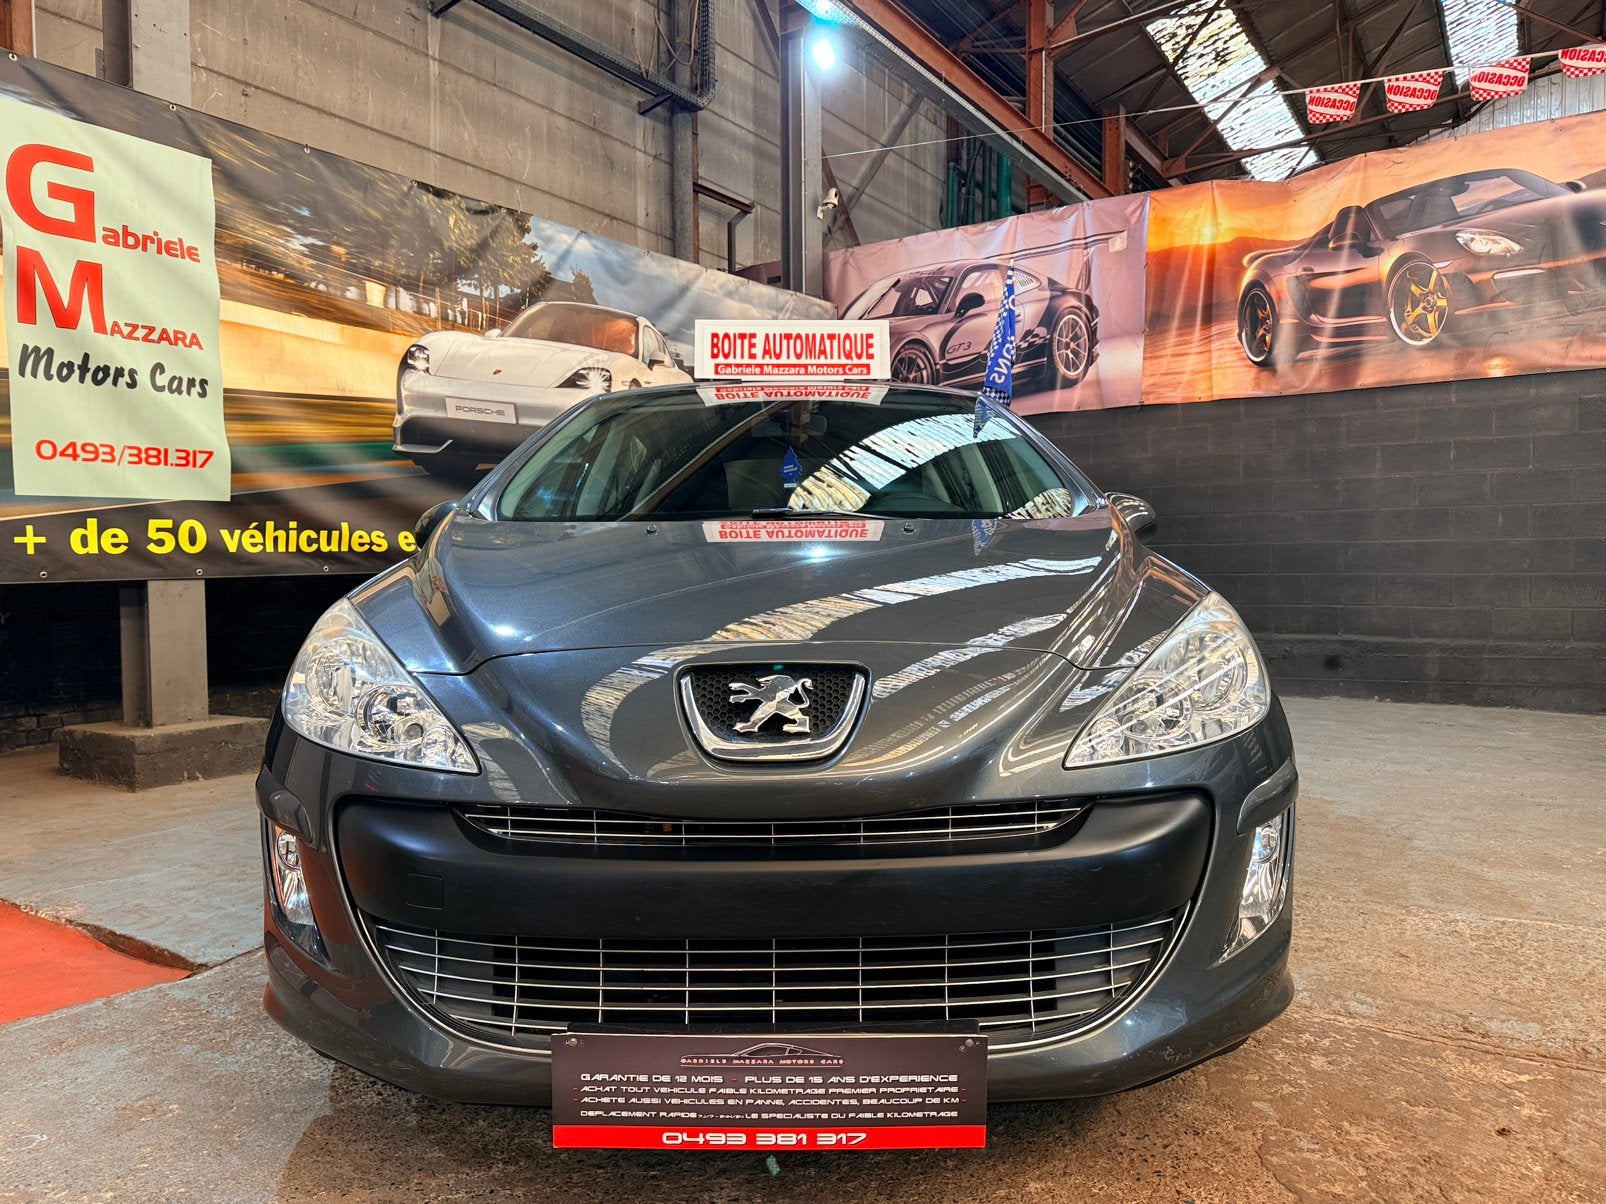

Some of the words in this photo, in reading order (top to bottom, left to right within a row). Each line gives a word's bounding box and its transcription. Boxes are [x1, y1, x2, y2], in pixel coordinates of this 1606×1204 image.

[16, 245, 204, 350] MAZZARA
[710, 332, 757, 360] BOITE
[762, 332, 875, 361] AUTOMATIQUE
[18, 343, 138, 390] Motors
[150, 362, 209, 399] Cars
[717, 364, 761, 375] Gabriele
[763, 365, 805, 375] Mazzara
[807, 365, 844, 375] Motors
[845, 364, 868, 375] Cars
[455, 405, 505, 416] PORSCHE
[35, 439, 215, 469] 0493/381.317
[69, 517, 129, 555] de
[147, 519, 208, 555] 50
[220, 520, 389, 554] véhicules
[580, 1073, 649, 1082] GARANTIE
[652, 1074, 671, 1083] DE
[674, 1075, 688, 1083] 12
[691, 1075, 724, 1083] MOIS
[745, 1075, 782, 1084] PLUS
[785, 1076, 805, 1084] DE
[808, 1076, 824, 1084] 15
[827, 1075, 856, 1084] ANS
[859, 1074, 958, 1084] D'EXPERIENCE
[580, 1085, 618, 1093] ACHAT
[653, 1086, 707, 1094] VEHICULE
[708, 1087, 748, 1095] FAIBLE
[828, 1087, 877, 1095] PREMIER
[879, 1086, 959, 1094] PROPRIETAIRE
[580, 1096, 626, 1104] ACHETE
[580, 1110, 658, 1118] DEPLACEMENT
[661, 1132, 747, 1145] 0493
[755, 1133, 808, 1145] 381
[816, 1132, 867, 1145] 317
